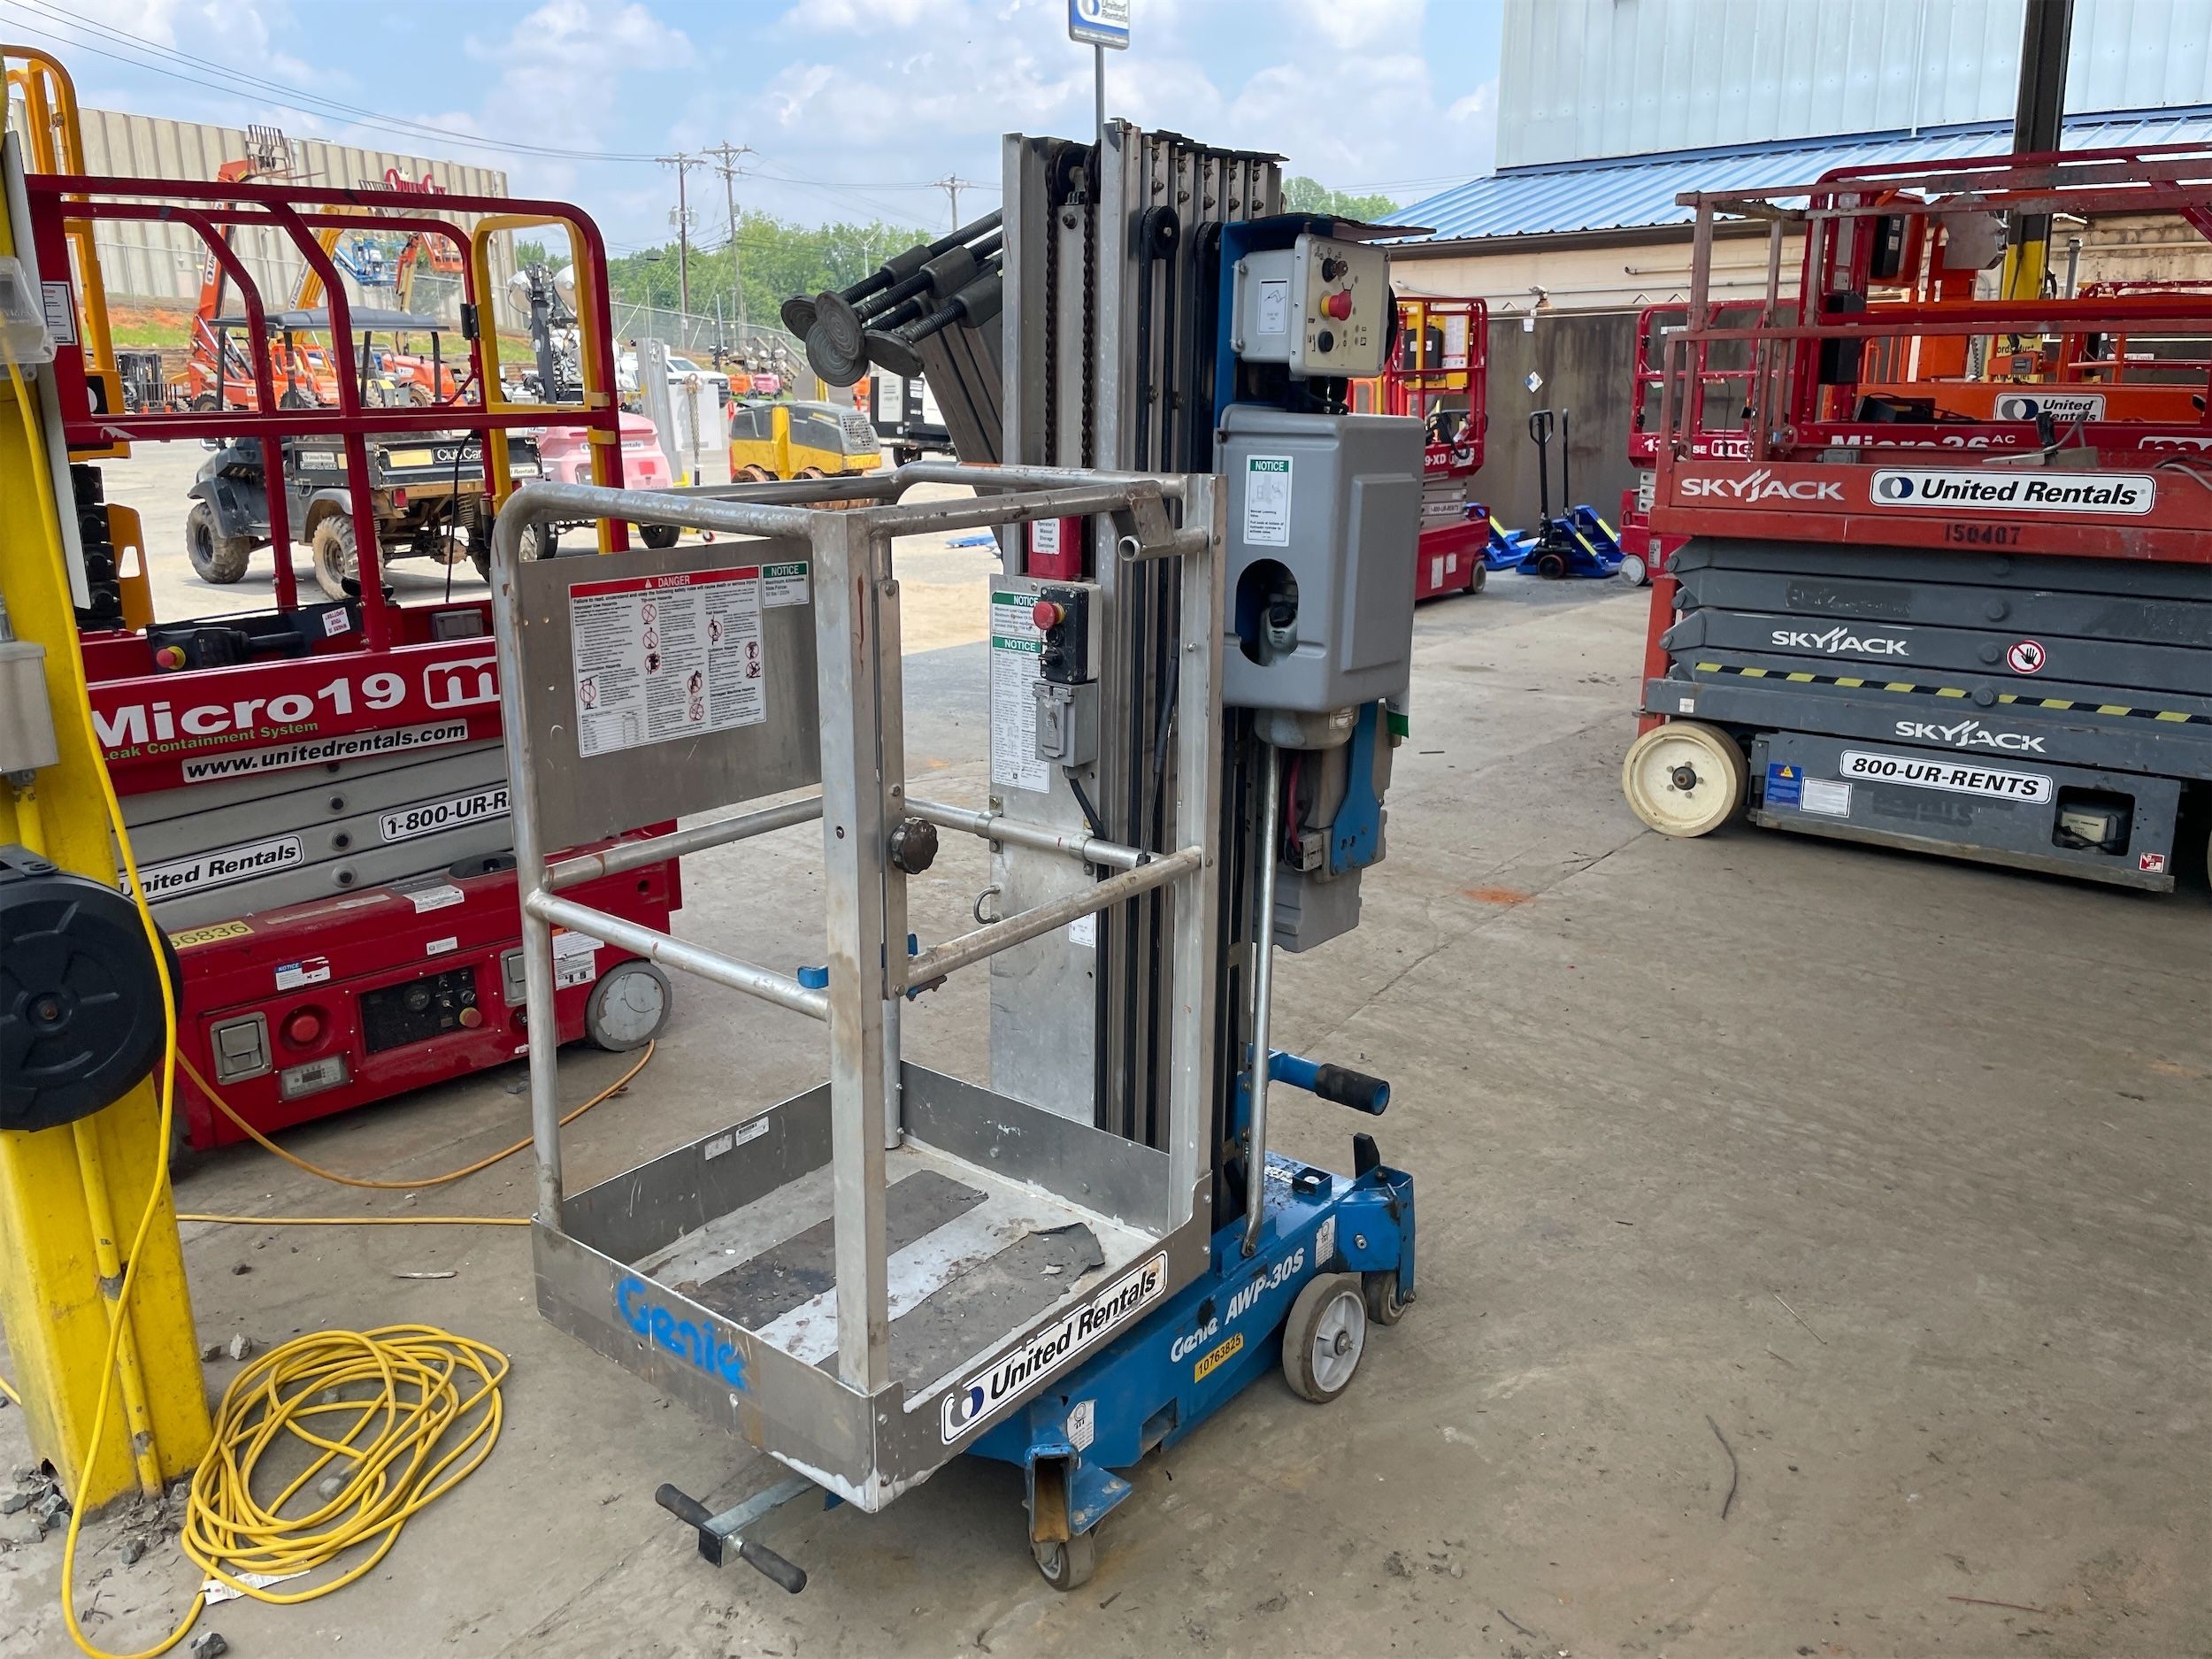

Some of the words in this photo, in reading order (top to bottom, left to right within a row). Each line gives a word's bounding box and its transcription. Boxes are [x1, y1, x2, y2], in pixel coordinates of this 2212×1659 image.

[2043, 399, 2093, 411] United
[1255, 460, 1285, 472] NOTICE
[1681, 468, 1845, 503] SKYJACK
[1921, 479, 2019, 502] United
[2024, 480, 2138, 505] Rentals
[657, 574, 690, 588] DANGER
[771, 565, 800, 577] NOTICE
[1013, 595, 1039, 607] NOTICE
[1004, 639, 1036, 652] NOTICE
[1771, 626, 1909, 657] SKYJACK
[91, 672, 406, 748] Micro19
[105, 746, 141, 760] eak
[147, 729, 256, 753] Containment
[260, 720, 319, 739] System
[187, 724, 465, 779] www.unitedrentals.com
[1894, 719, 2047, 753] SKYJACK
[1852, 757, 2039, 796] 800-UR-RENTS
[208, 844, 296, 878] Rentals
[278, 962, 300, 972] NOTICE
[1171, 1317, 1218, 1363] Genie
[1225, 1247, 1305, 1325] AWP-30S
[616, 1275, 748, 1391] Genie
[991, 1323, 1072, 1401] United
[1077, 1270, 1156, 1341] Rentals
[1198, 1333, 1242, 1375] 10763825
